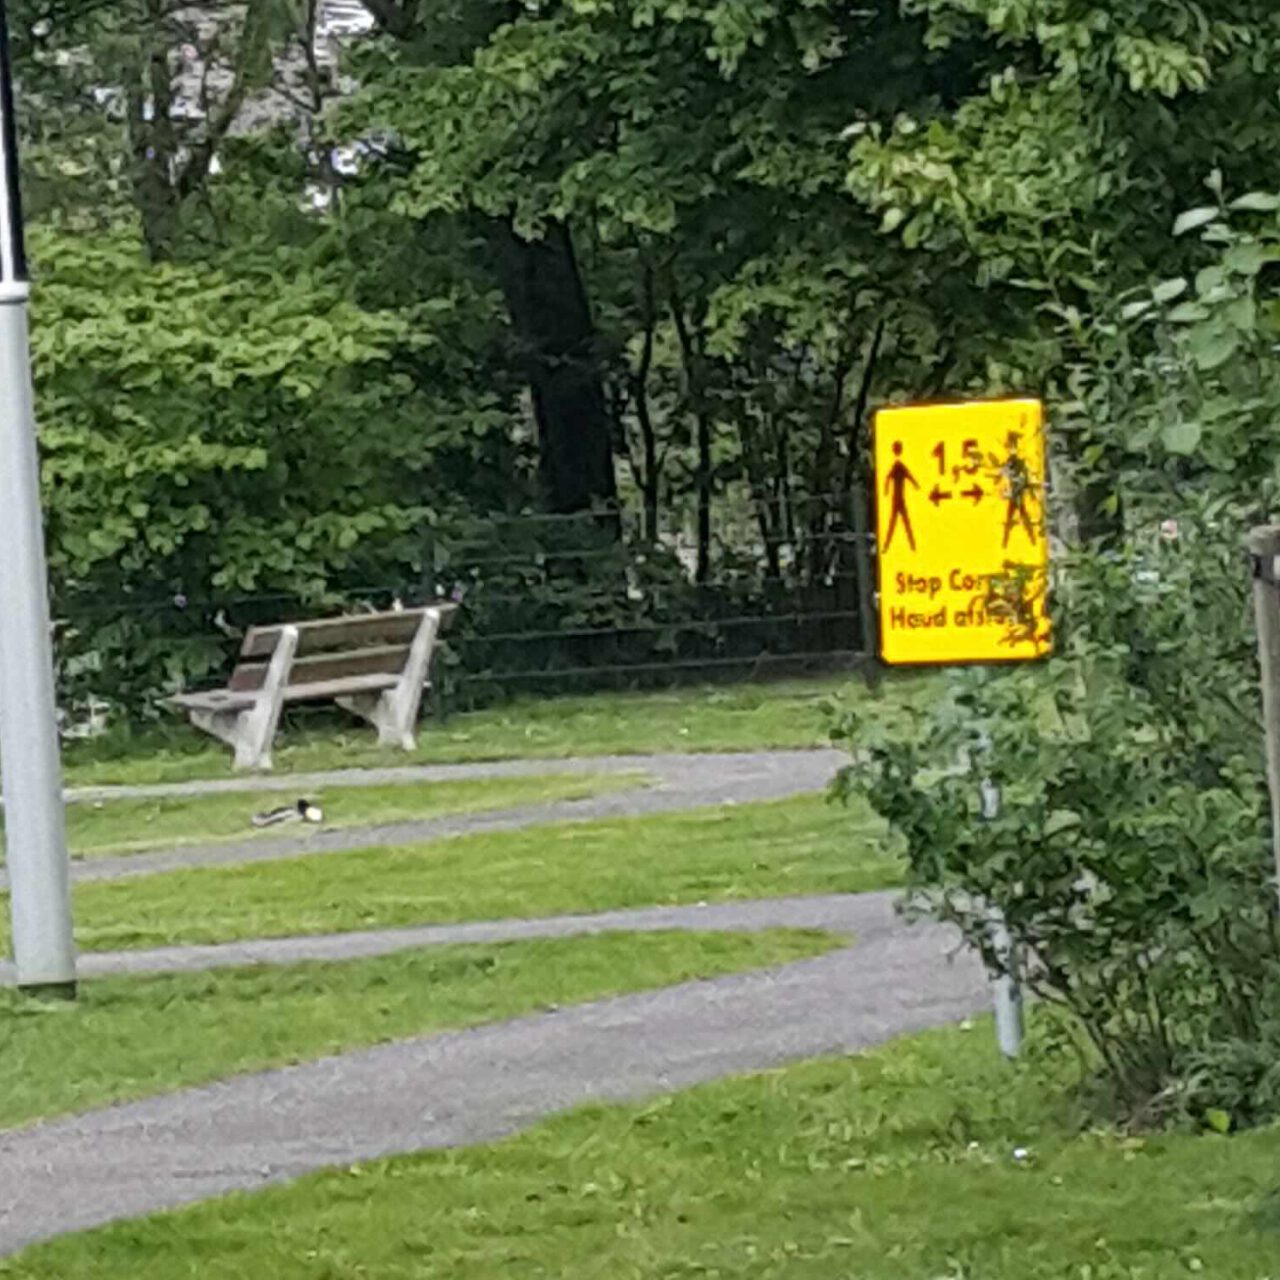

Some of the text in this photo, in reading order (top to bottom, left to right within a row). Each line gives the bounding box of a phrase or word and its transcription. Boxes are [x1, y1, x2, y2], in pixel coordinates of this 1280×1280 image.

[931, 438, 984, 483] 1,5
[896, 571, 942, 599] Stop
[890, 606, 947, 629] Houd
